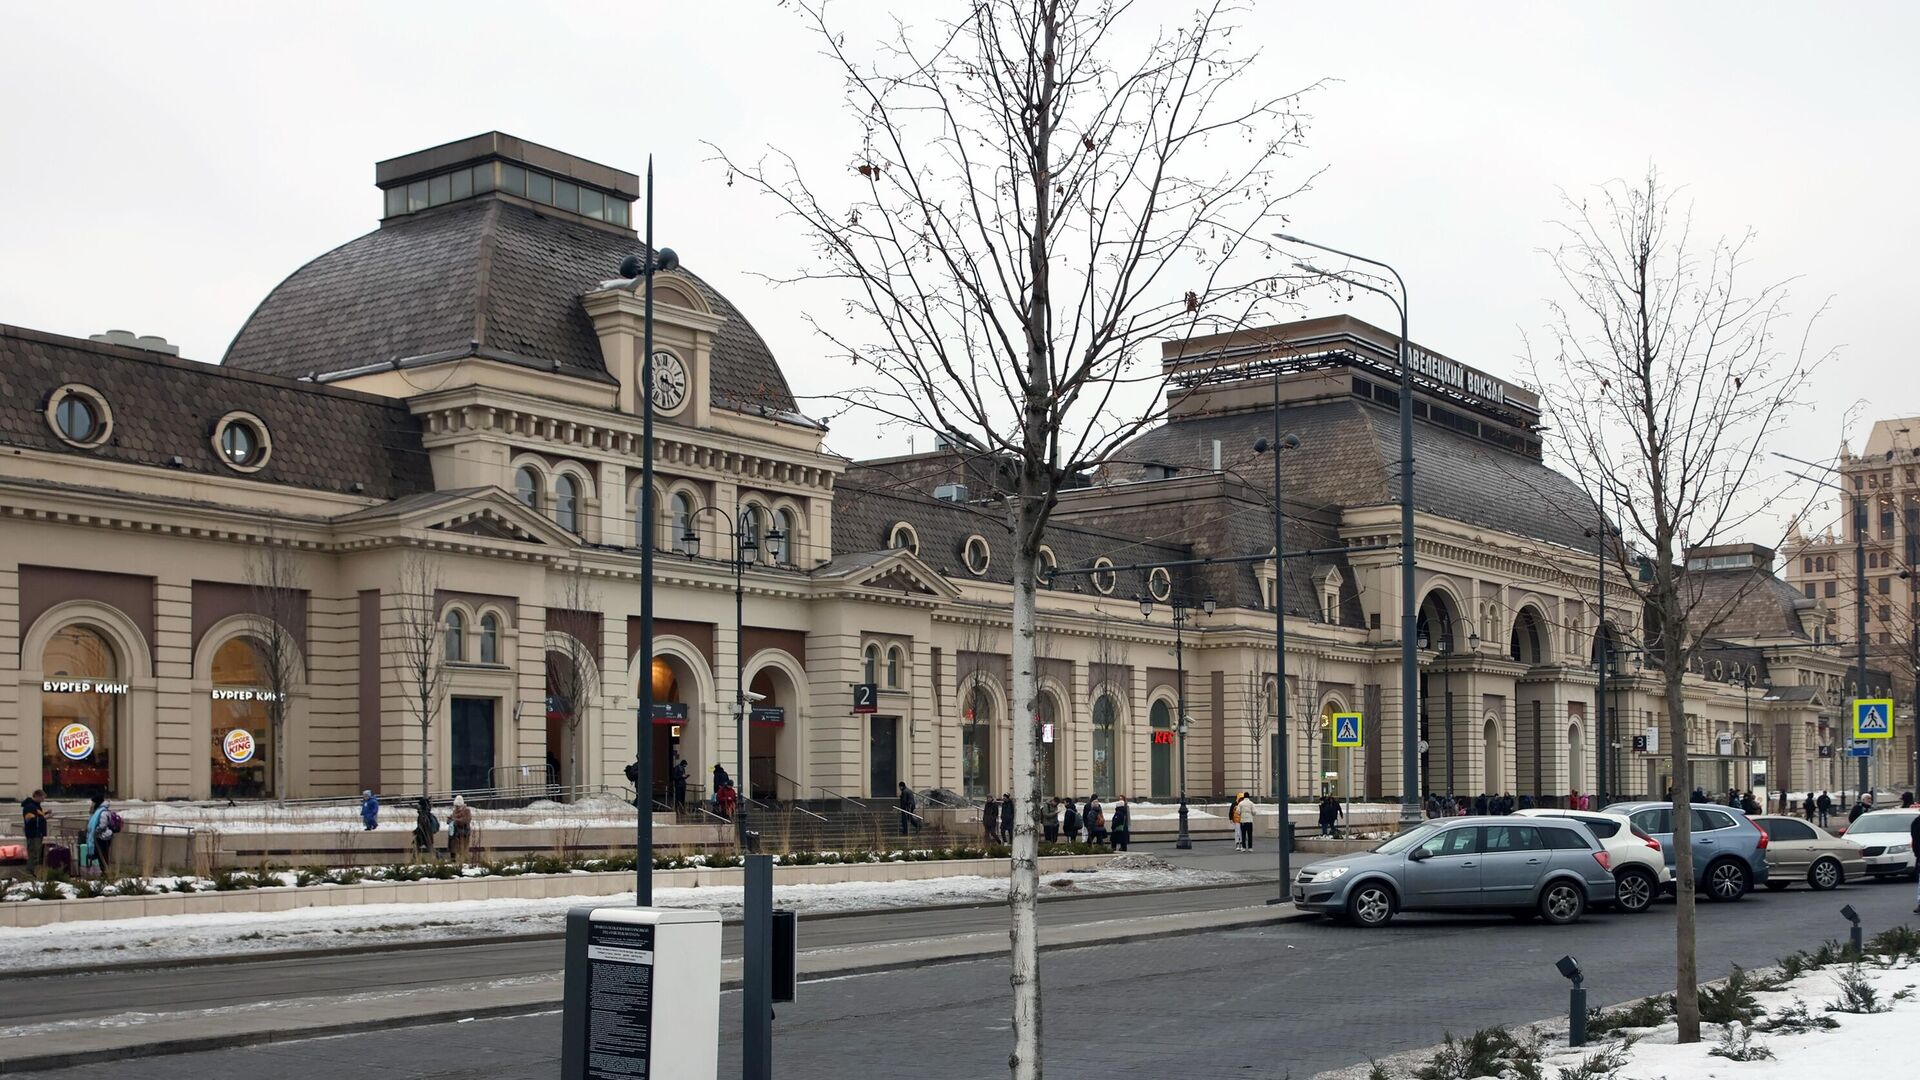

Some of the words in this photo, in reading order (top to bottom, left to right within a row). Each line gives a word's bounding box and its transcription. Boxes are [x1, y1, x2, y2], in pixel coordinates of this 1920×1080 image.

[1467, 371, 1504, 404] ВОКЗАЛ
[43, 681, 91, 692] БУРГЕР
[95, 683, 129, 694] КИНГ
[212, 689, 253, 701] БУРГЕР
[860, 686, 870, 704] 2
[63, 730, 89, 743] BURGER
[1637, 736, 1645, 748] 3
[65, 737, 90, 751] KING
[229, 742, 251, 755] KING
[1821, 746, 1829, 756] 4
